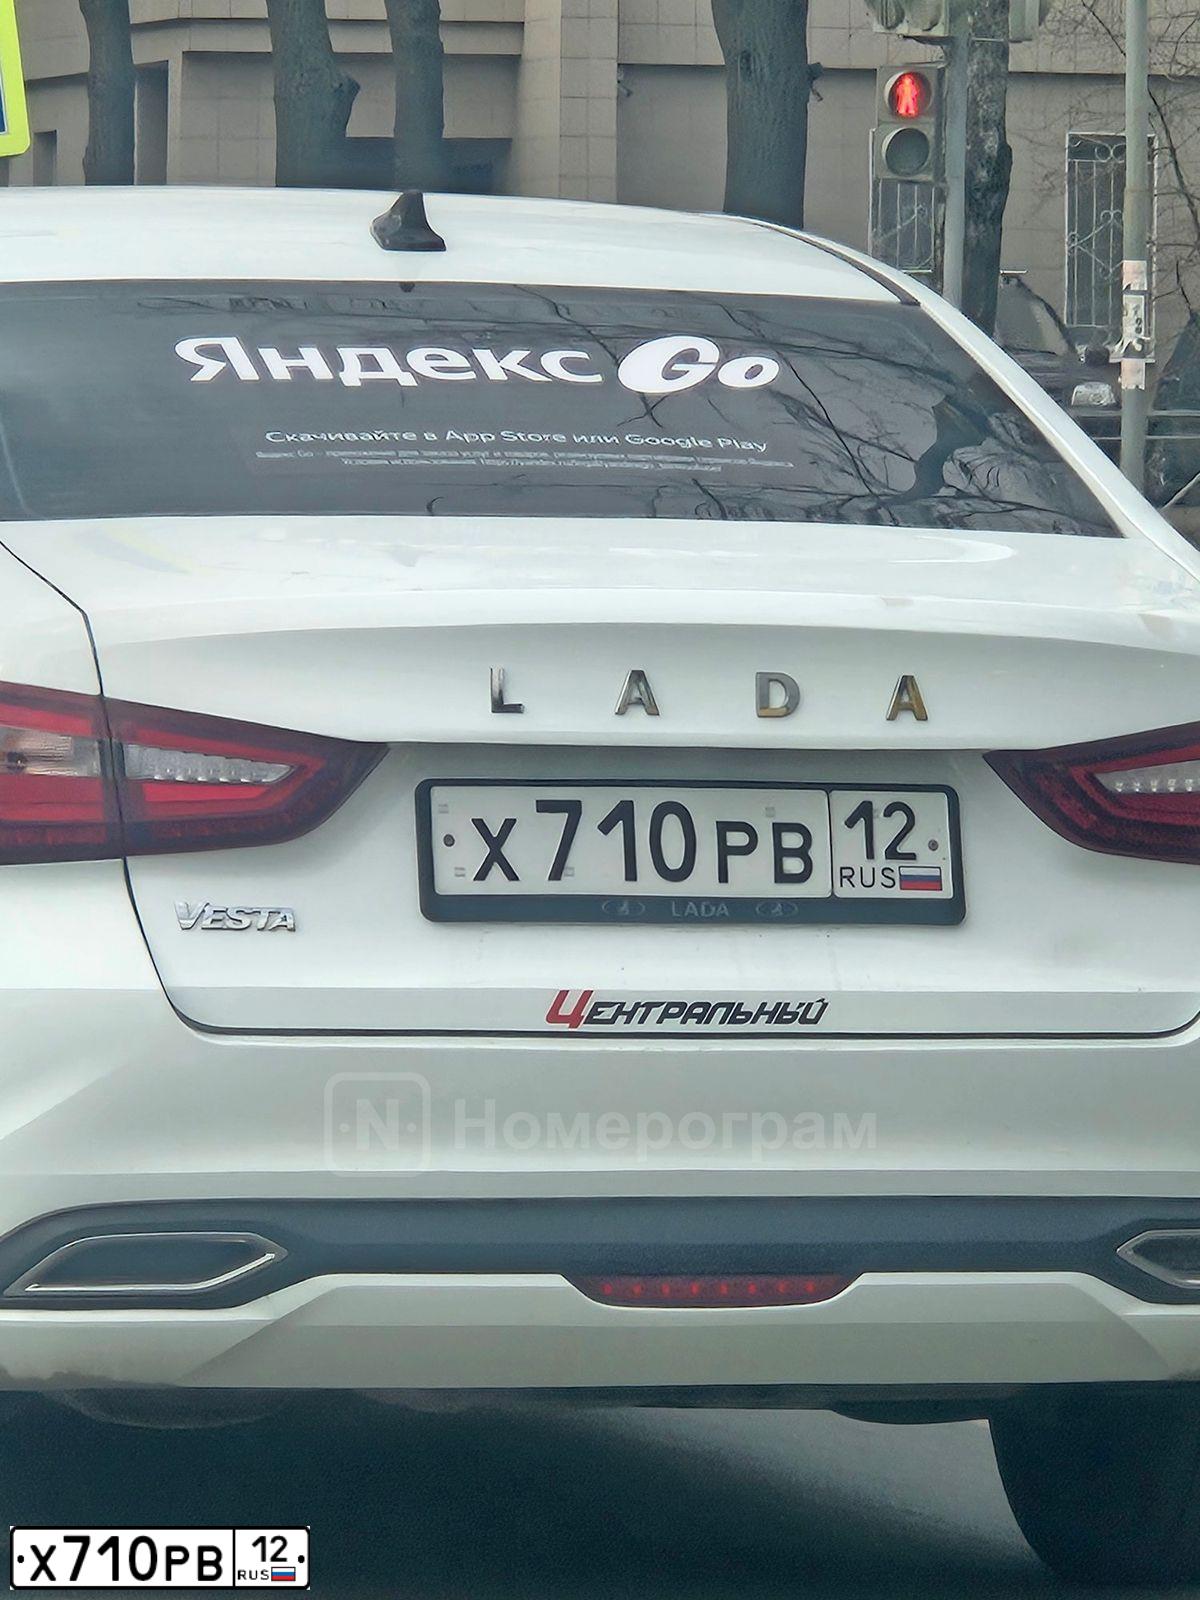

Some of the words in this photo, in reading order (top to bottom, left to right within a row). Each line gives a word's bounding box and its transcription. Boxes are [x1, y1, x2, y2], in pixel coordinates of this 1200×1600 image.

[174, 336, 603, 387] Яндекс
[617, 335, 781, 394] Go
[265, 430, 418, 443] Скачивайте
[423, 432, 438, 441] в
[446, 430, 496, 444] App
[500, 430, 567, 443] Store
[572, 433, 620, 445] или
[624, 434, 713, 449] Google
[717, 437, 767, 453] Play
[489, 667, 928, 722] LADA
[843, 800, 918, 861] 12
[839, 866, 897, 889] RUS
[174, 900, 296, 932] VESTA
[671, 901, 730, 918] LADA
